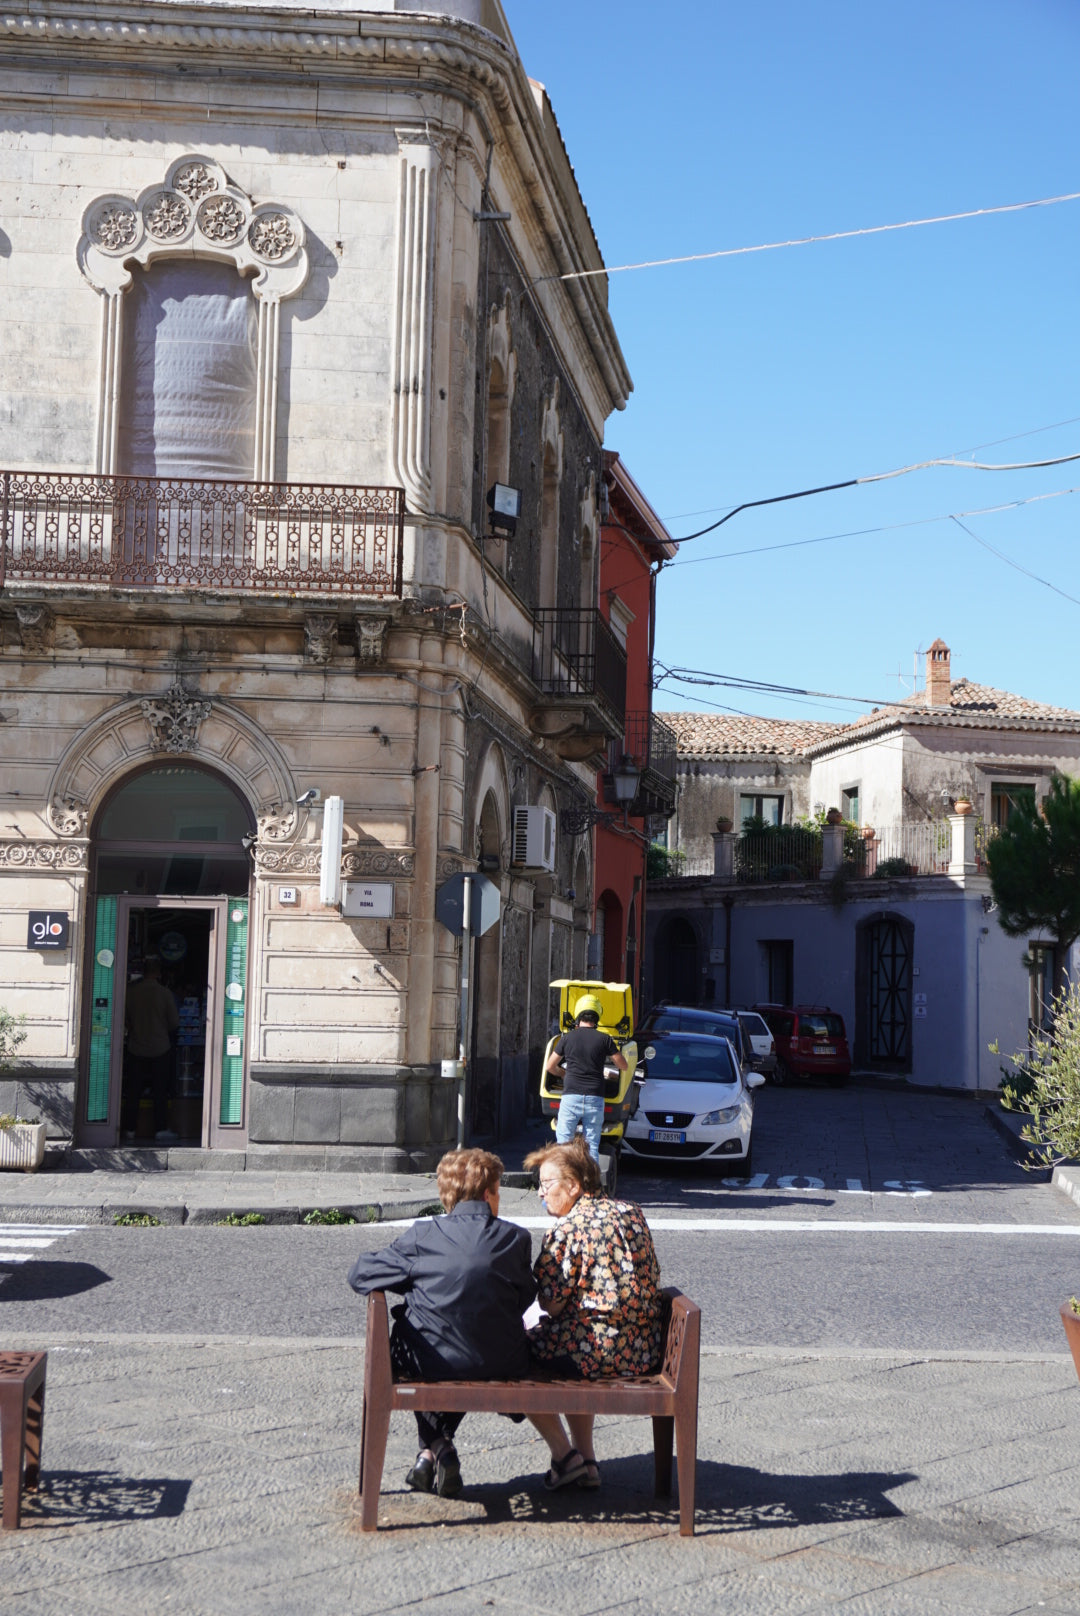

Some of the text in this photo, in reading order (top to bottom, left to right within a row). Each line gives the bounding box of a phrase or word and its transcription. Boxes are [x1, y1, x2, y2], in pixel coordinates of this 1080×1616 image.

[283, 891, 292, 899] 32
[32, 915, 63, 940] glo
[721, 1173, 933, 1198] STOP
